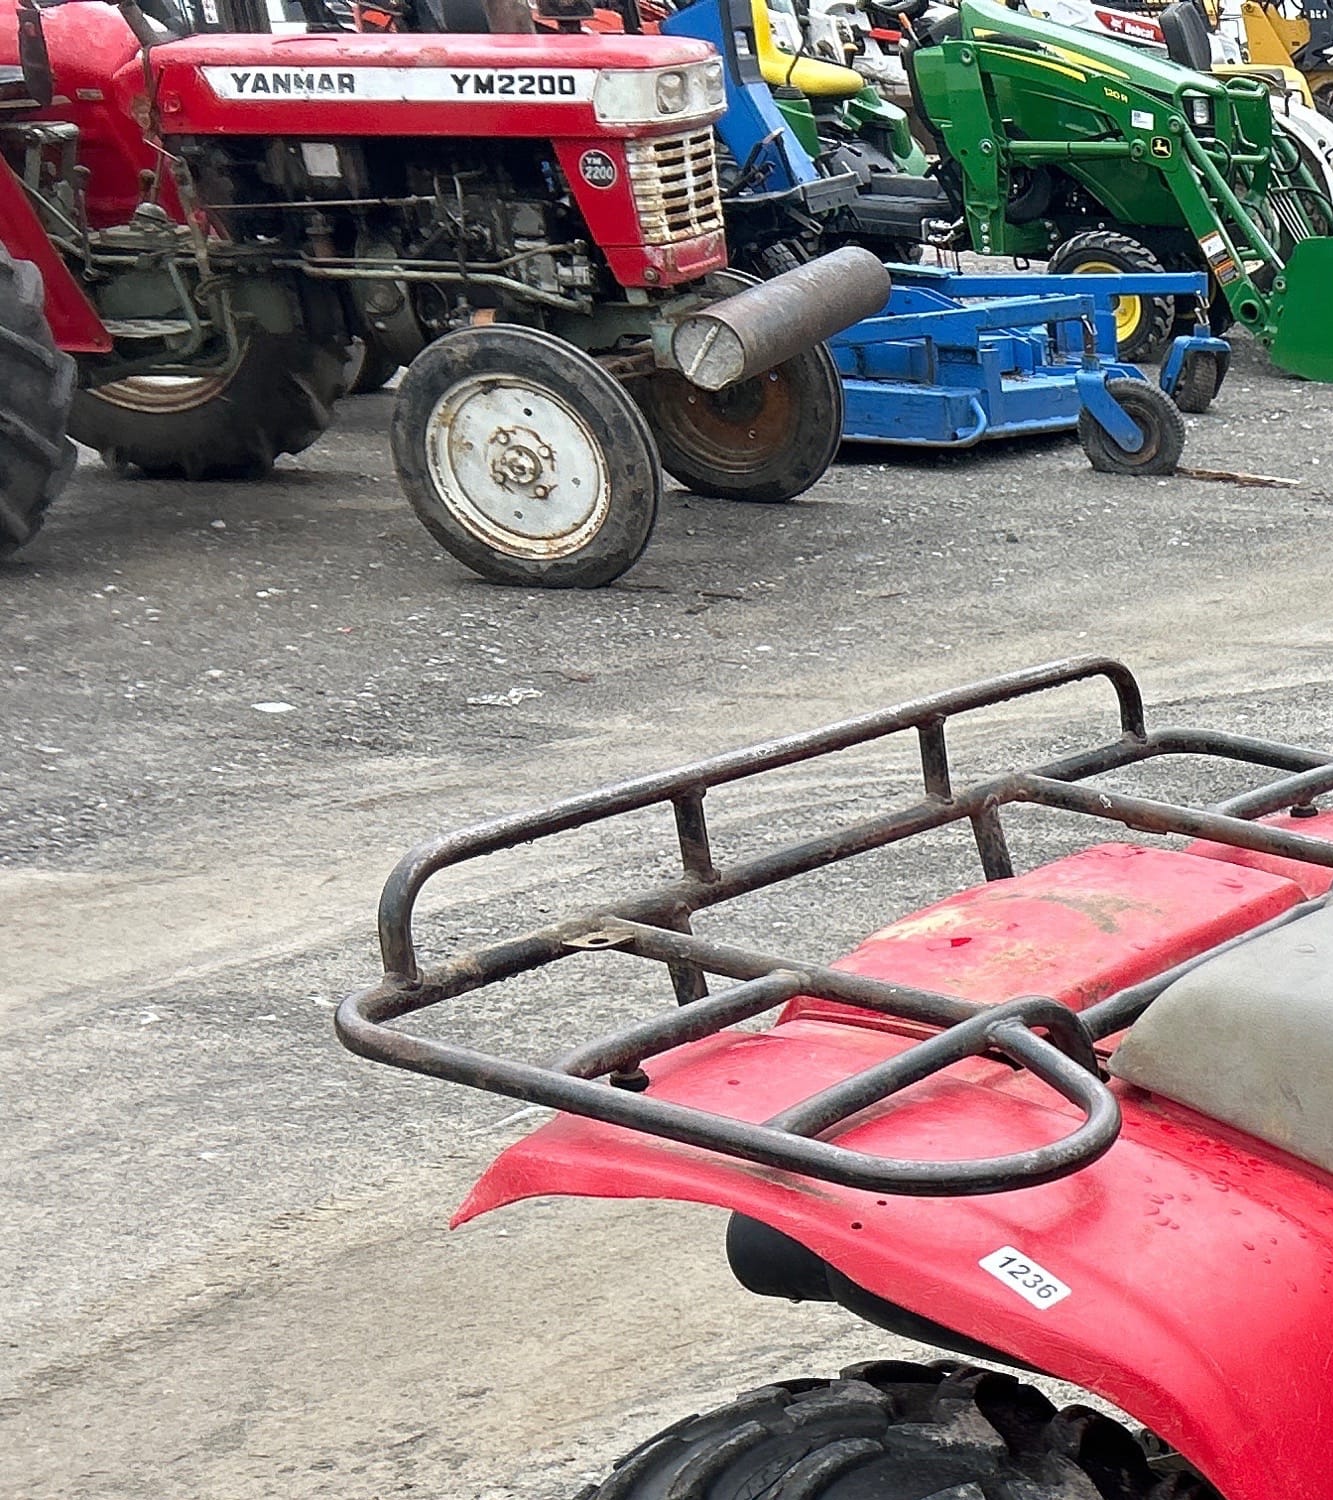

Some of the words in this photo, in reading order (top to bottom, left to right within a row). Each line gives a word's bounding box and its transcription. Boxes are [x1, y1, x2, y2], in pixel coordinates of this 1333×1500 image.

[1124, 22, 1155, 40] Bobcat
[231, 72, 356, 94] YANMAR
[450, 73, 576, 96] YM2200
[585, 156, 602, 165] YM
[585, 166, 613, 179] 2200
[999, 1256, 1058, 1299] 1236
